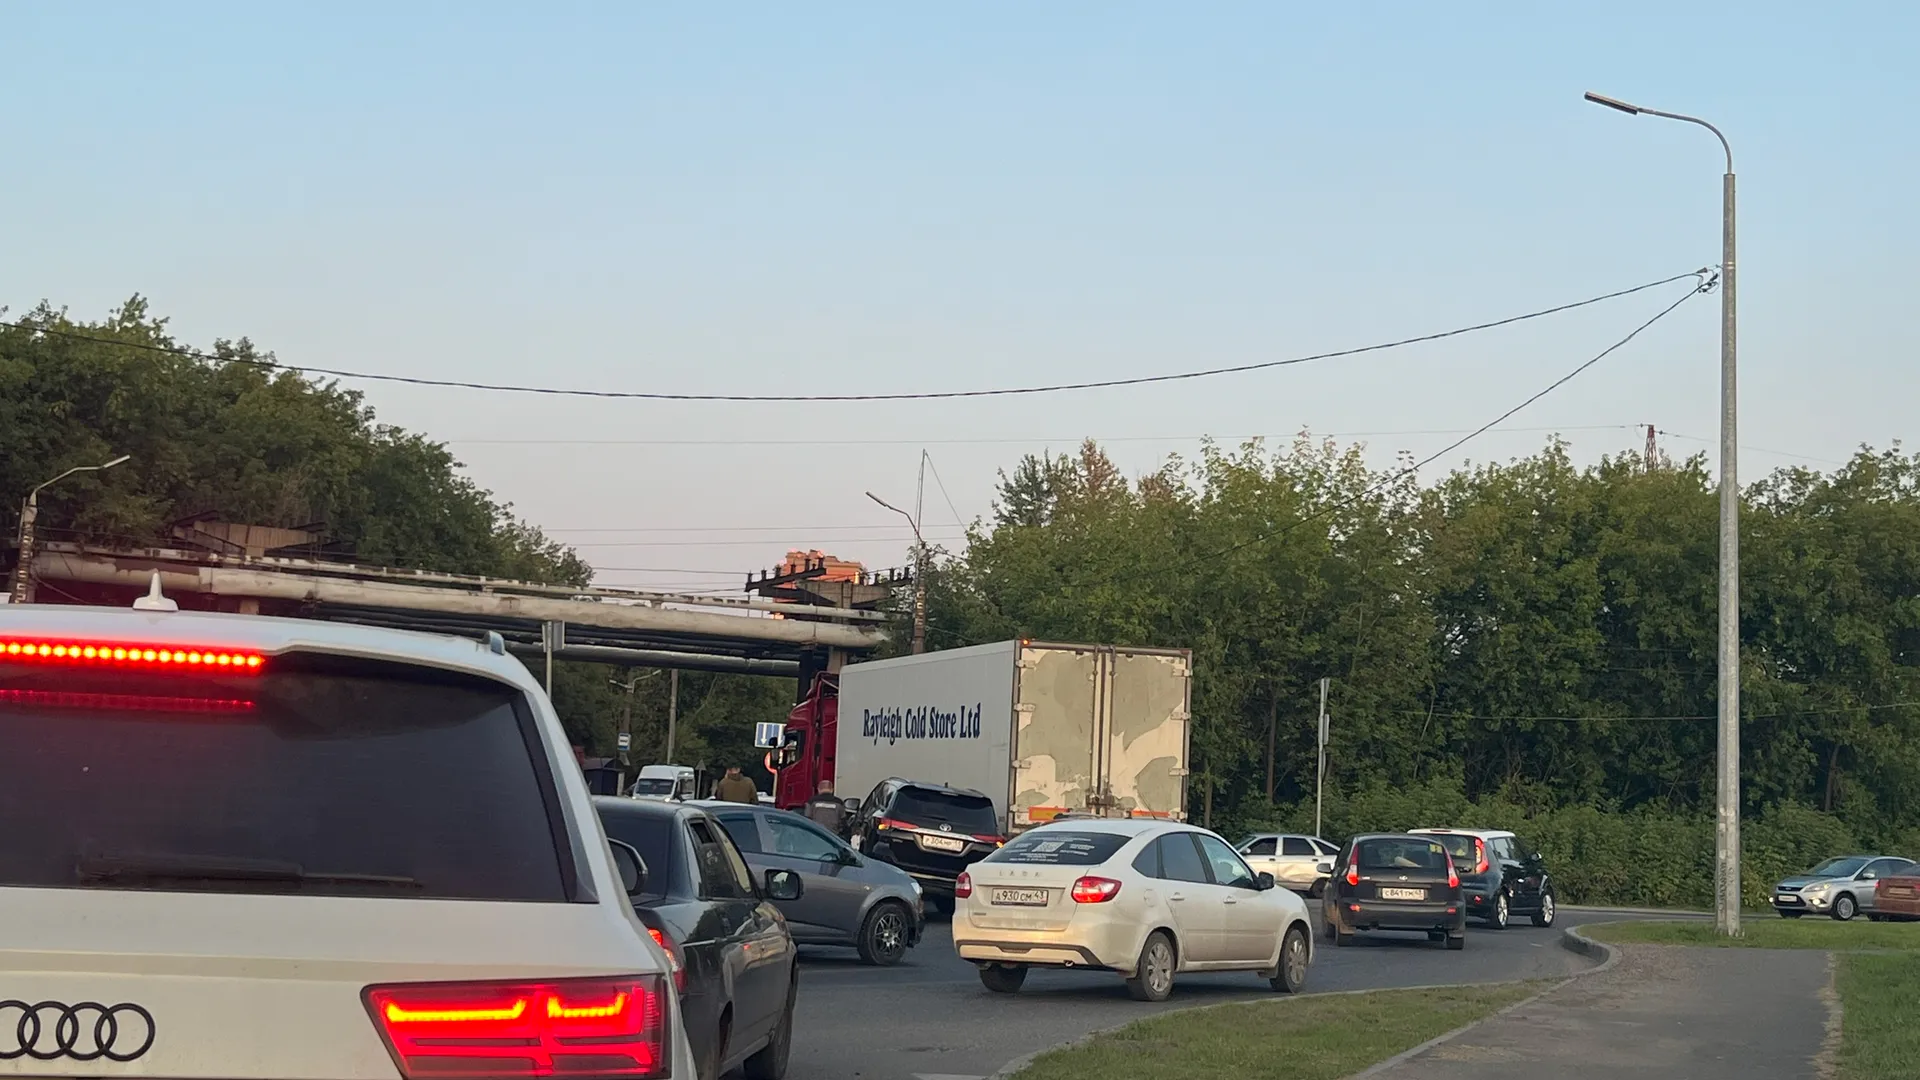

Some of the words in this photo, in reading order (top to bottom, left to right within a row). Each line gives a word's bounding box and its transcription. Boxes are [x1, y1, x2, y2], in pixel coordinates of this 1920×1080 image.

[863, 707, 902, 746] Rayleigh
[905, 706, 927, 740] Cold
[929, 706, 957, 740] Store
[959, 702, 981, 740] Ltd
